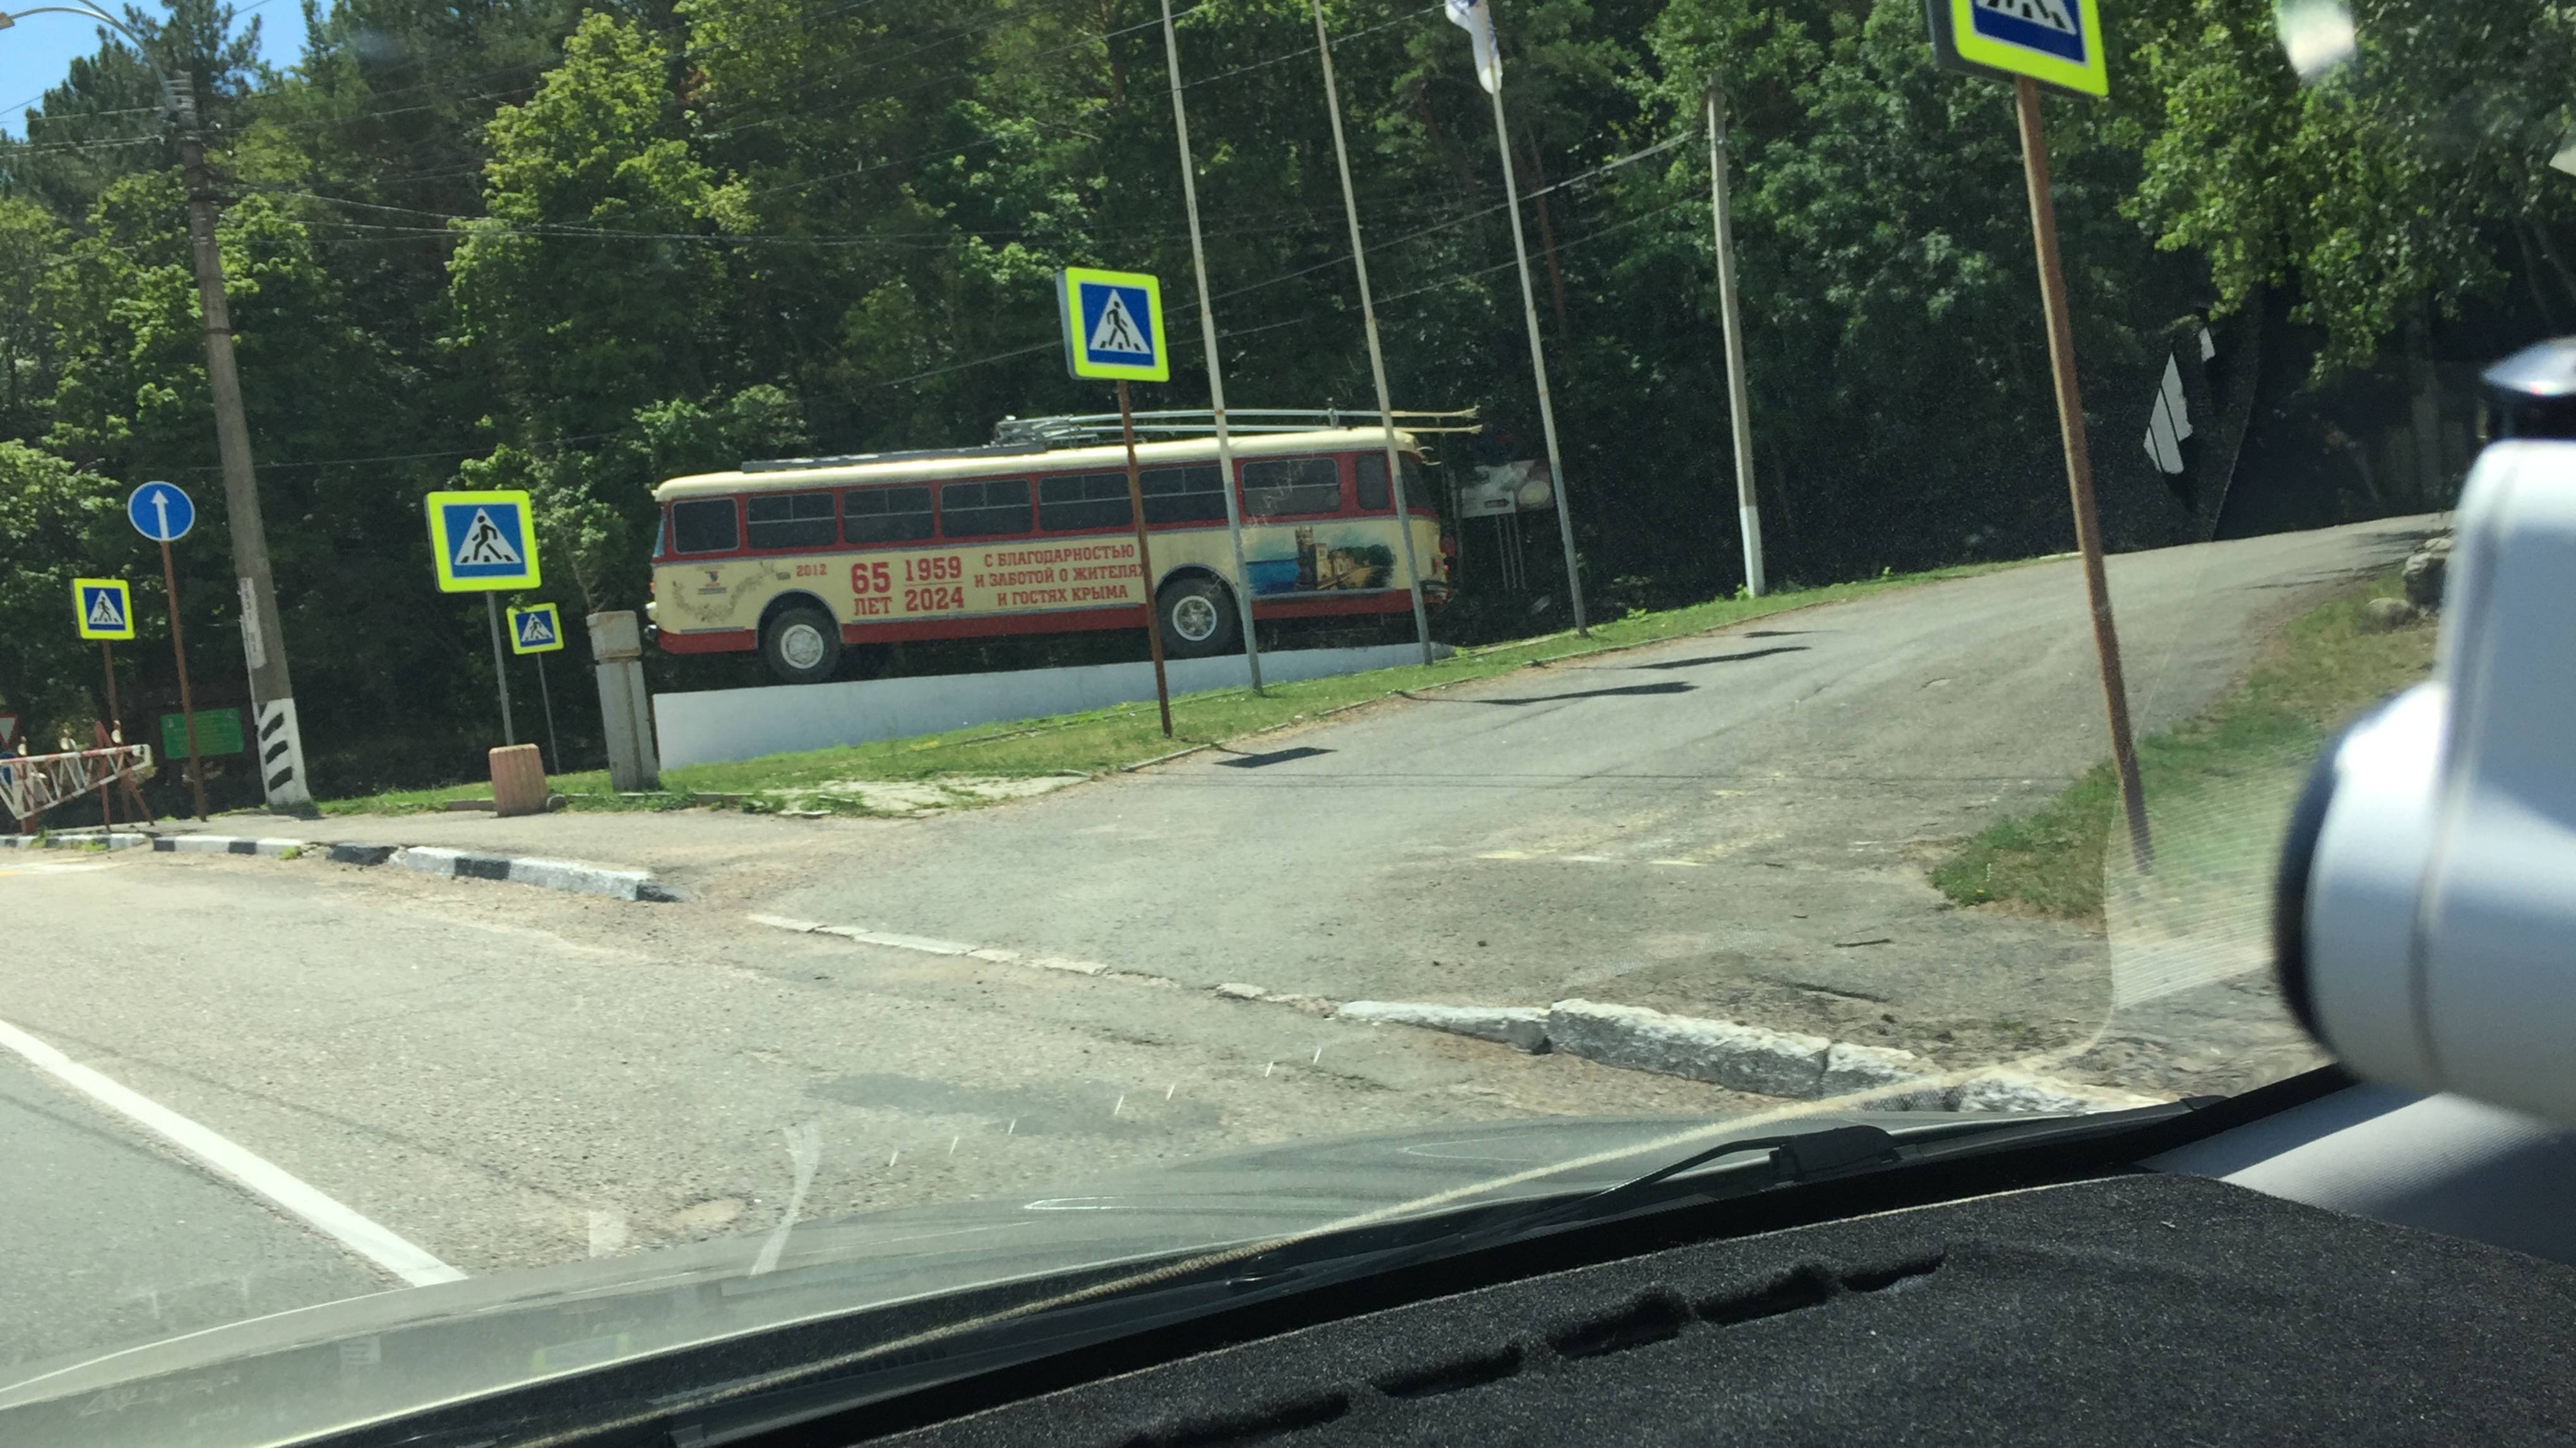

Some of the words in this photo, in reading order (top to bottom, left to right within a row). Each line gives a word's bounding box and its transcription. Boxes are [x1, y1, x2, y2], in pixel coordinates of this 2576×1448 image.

[984, 554, 993, 567] С
[998, 544, 1135, 566] БЛАГОДАРНОСТЬЮ
[796, 563, 827, 577] 2012
[850, 562, 891, 595] 65
[905, 556, 962, 581] 1959
[974, 574, 985, 588] И
[989, 568, 1054, 587] ЗАБОТОЙ
[1059, 569, 1068, 582] О
[854, 596, 892, 616] ЛЕТ
[905, 586, 965, 612] 2024
[997, 593, 1008, 606] И
[1011, 588, 1068, 605] ГОСТЯХ
[1071, 585, 1128, 600] КРЫМА
